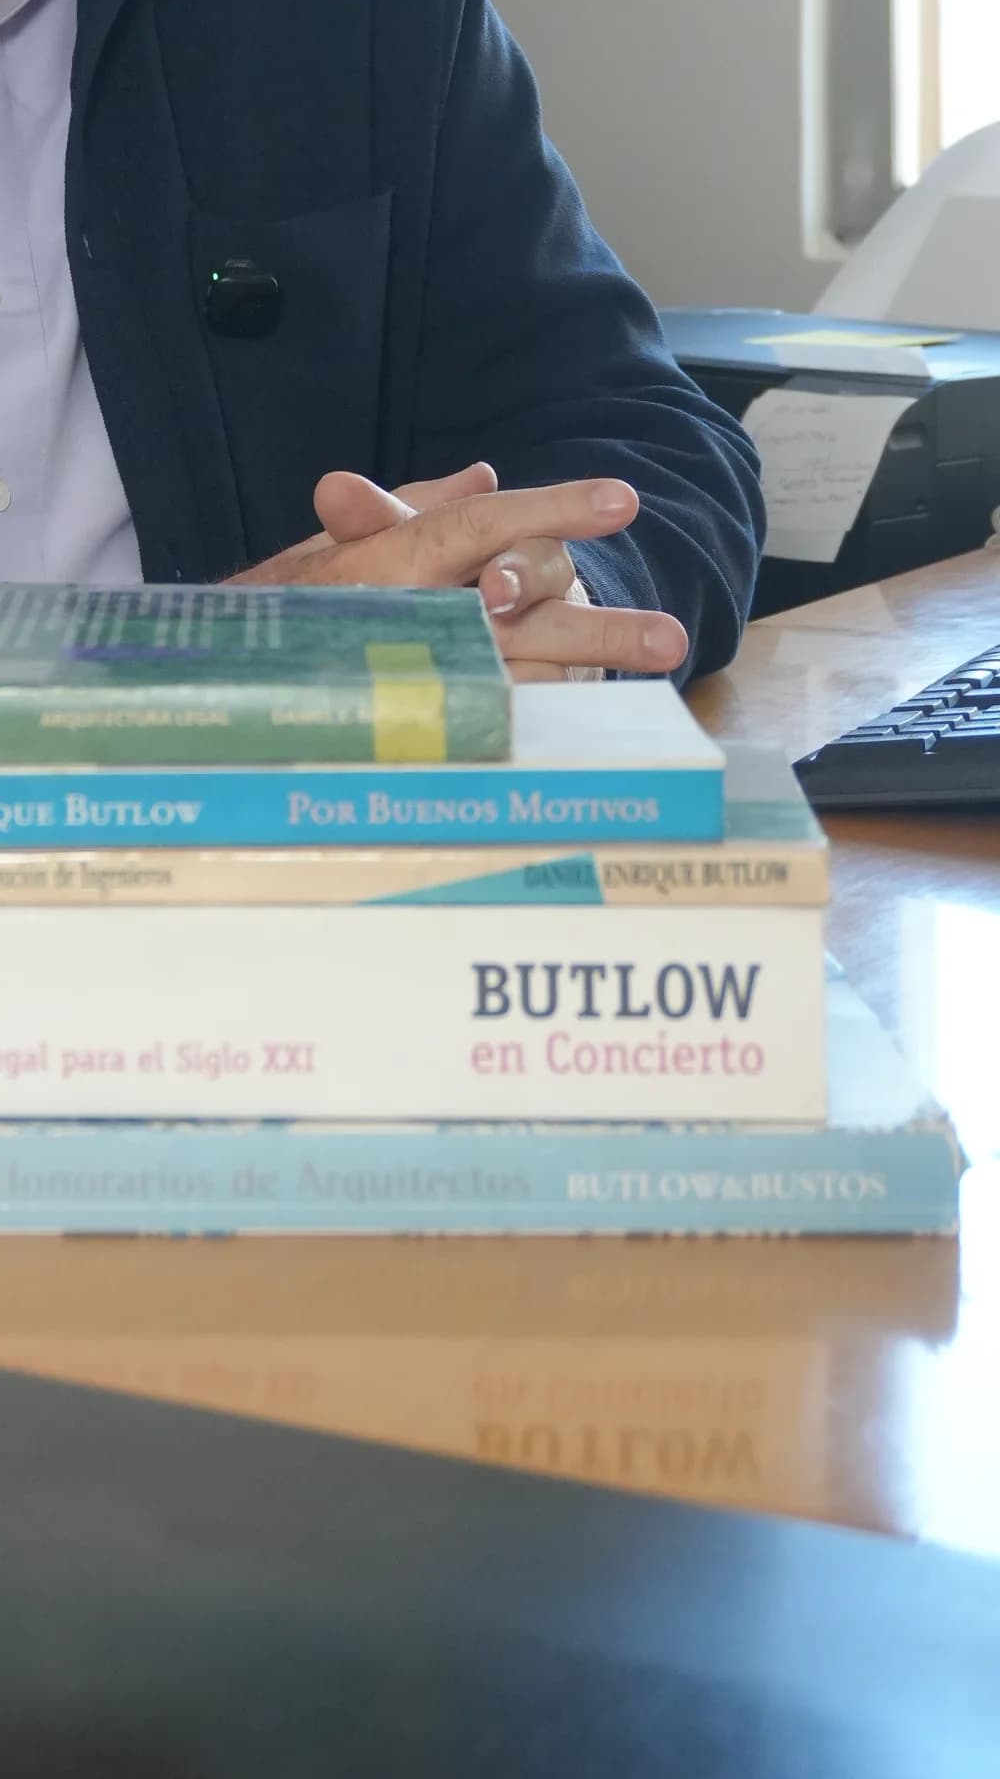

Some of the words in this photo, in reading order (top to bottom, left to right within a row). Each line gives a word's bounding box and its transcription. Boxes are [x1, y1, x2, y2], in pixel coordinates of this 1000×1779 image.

[64, 793, 202, 827] BUTLOW
[288, 793, 357, 825] POR
[368, 792, 498, 825] BUENOS
[508, 791, 660, 823] MOTIVOS
[524, 862, 599, 890] DANIEL
[605, 862, 697, 896] ENRIQUE
[703, 860, 790, 888] BUTLOW
[471, 964, 761, 1019] BUTLOW
[61, 1049, 126, 1079] para
[138, 1042, 166, 1072] el
[176, 1042, 251, 1080] Siglo
[262, 1043, 316, 1074] XXI
[471, 1039, 525, 1076] en
[545, 1031, 765, 1077] Concierto
